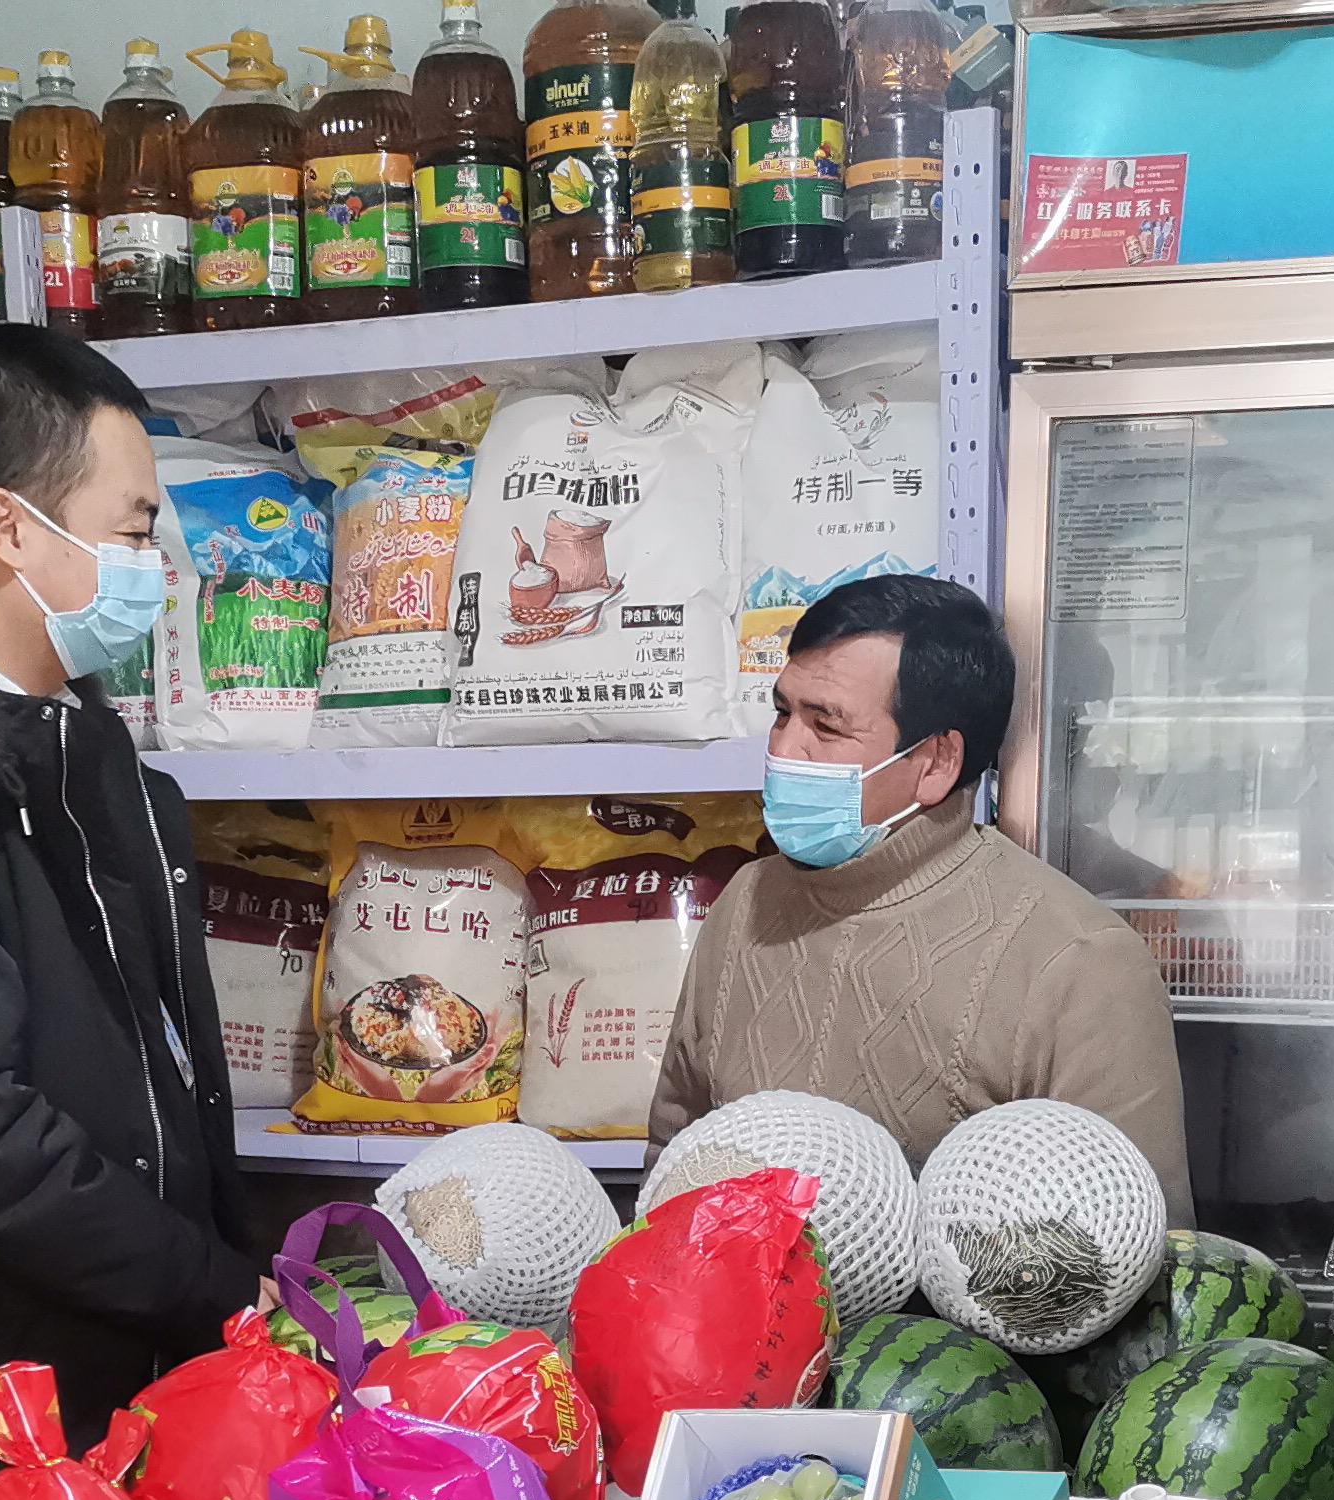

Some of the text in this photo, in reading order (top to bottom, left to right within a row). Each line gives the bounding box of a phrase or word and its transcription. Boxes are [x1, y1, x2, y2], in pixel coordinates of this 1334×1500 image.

[549, 120, 590, 140] 玉米油
[502, 471, 640, 507] 白珍珠面粉
[791, 468, 923, 503] 特制一等
[375, 495, 452, 526] 小麦粉
[236, 577, 326, 605] 小麦粉
[340, 571, 434, 627] 特制
[635, 647, 685, 662] 小麦粉
[744, 650, 784, 667] 小麦粉
[351, 902, 491, 941] 艾屯巴哈
[549, 907, 579, 925] RICE
